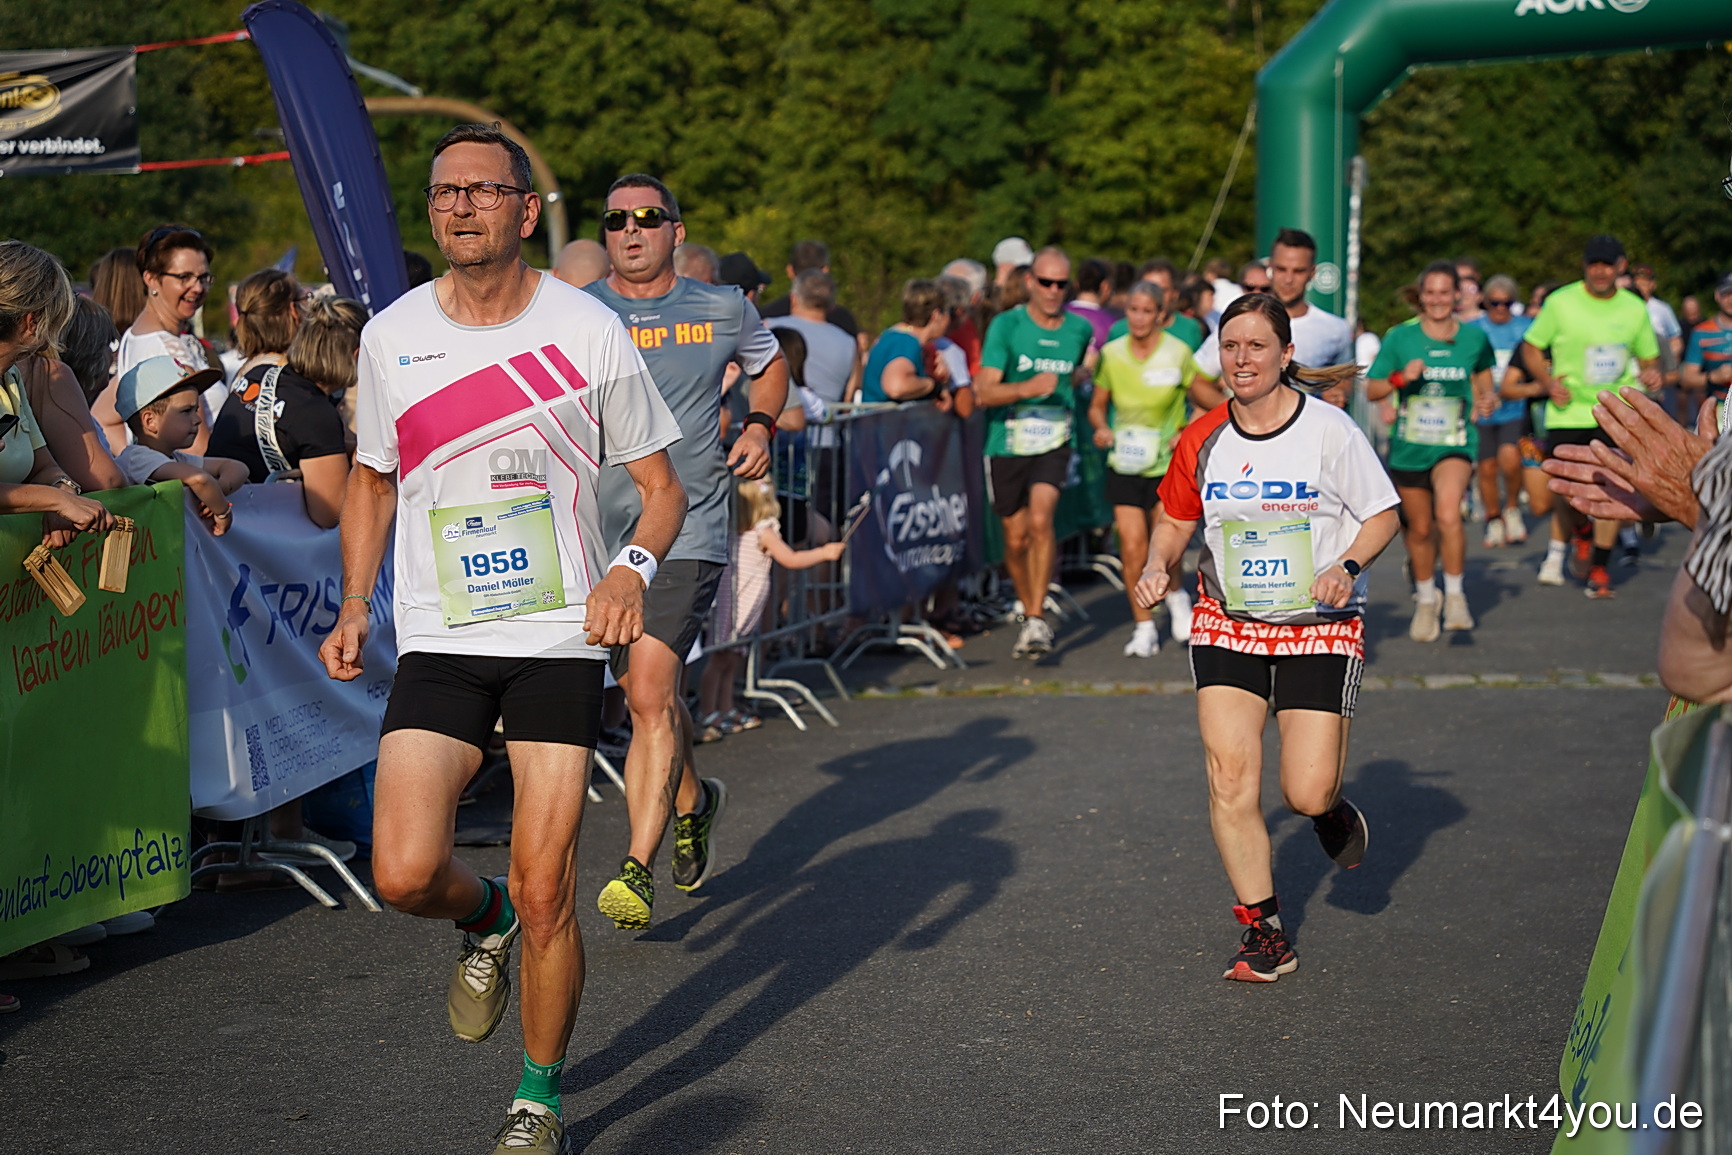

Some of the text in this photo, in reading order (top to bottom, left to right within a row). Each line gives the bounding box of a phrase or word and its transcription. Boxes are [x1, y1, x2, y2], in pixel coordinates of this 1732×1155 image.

[17, 136, 106, 154] verbindet.
[626, 325, 669, 348] ler
[489, 448, 546, 475] OM
[1261, 496, 1319, 512] energie
[461, 524, 497, 537] Firmenlauf
[460, 548, 529, 577] 1958
[1241, 559, 1288, 577] 2371
[468, 577, 535, 593] Daniel Möller
[1240, 622, 1295, 639] AVIA
[1300, 621, 1354, 640] AVIA
[1213, 634, 1270, 656] AVIA
[1273, 636, 1321, 656] AVIA
[13, 615, 90, 696] laufen
